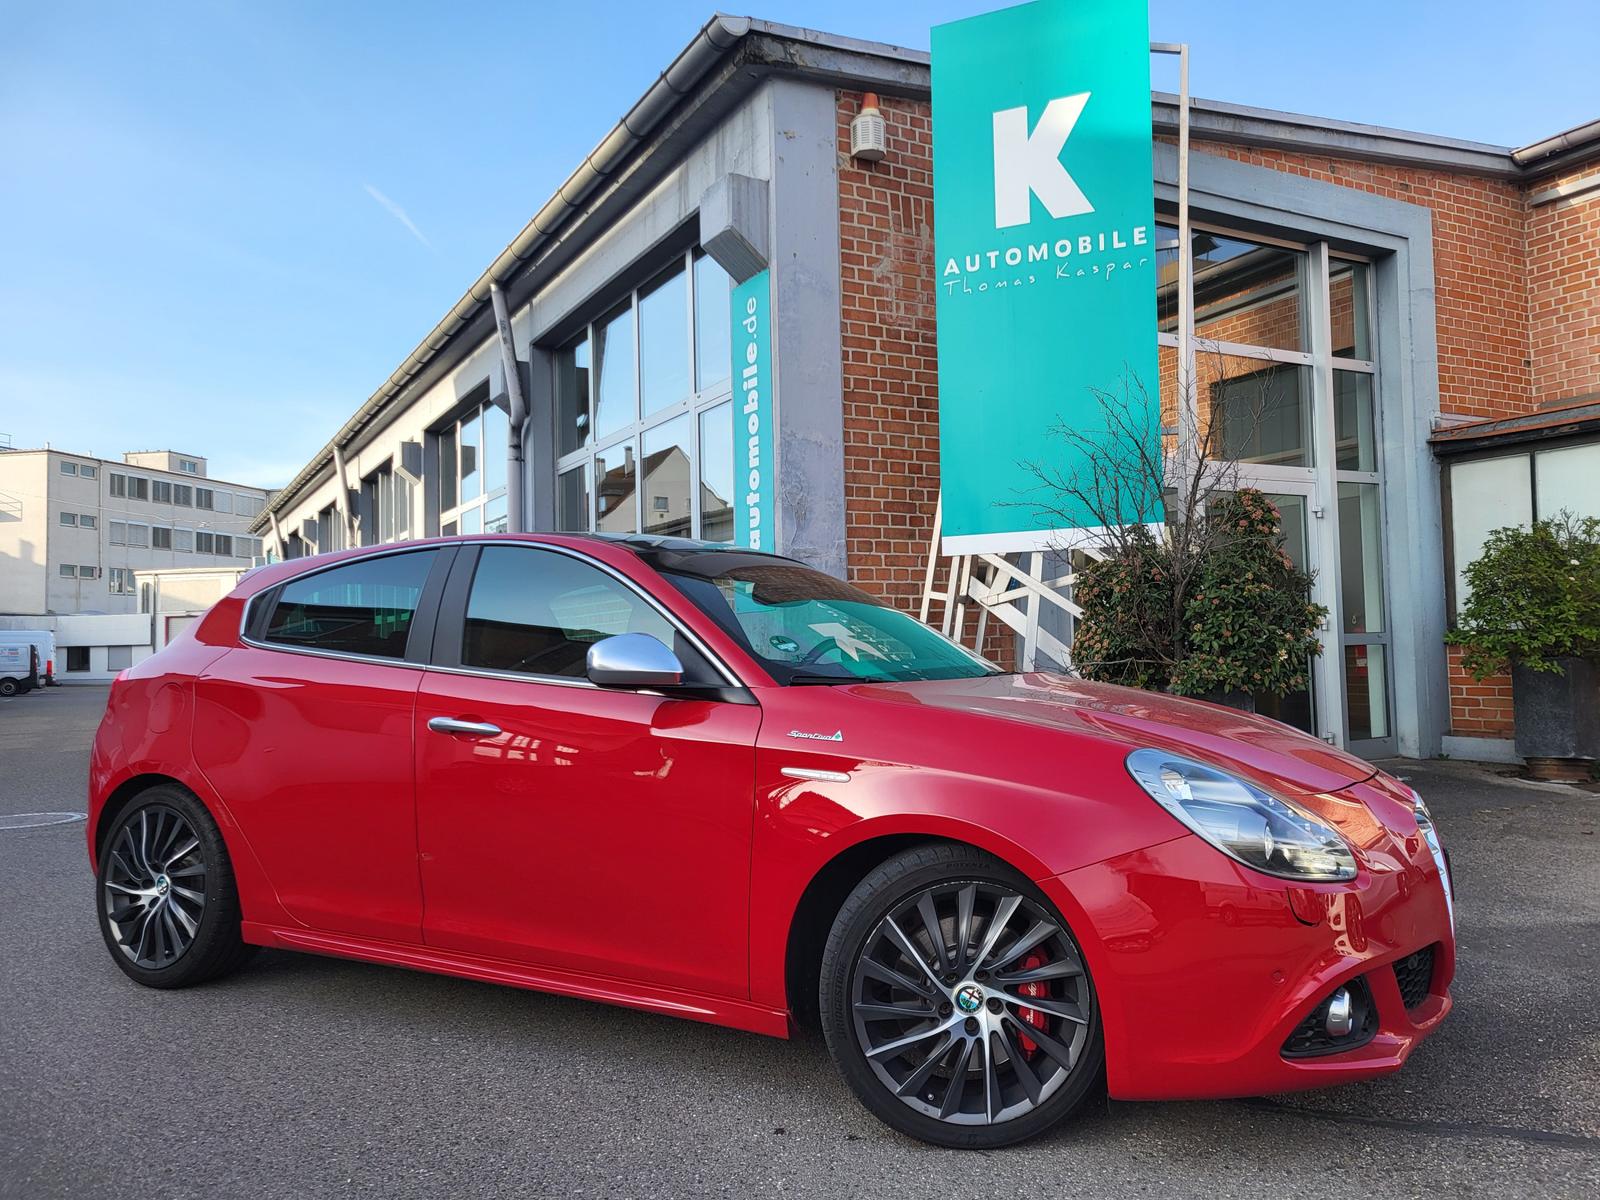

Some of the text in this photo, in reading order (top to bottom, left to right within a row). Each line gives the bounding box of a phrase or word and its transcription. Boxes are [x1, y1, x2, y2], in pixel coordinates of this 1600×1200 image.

[992, 91, 1095, 229] K
[943, 226, 1148, 276] AUTOMOBILE
[943, 257, 1148, 296] Thomas Kaspar
